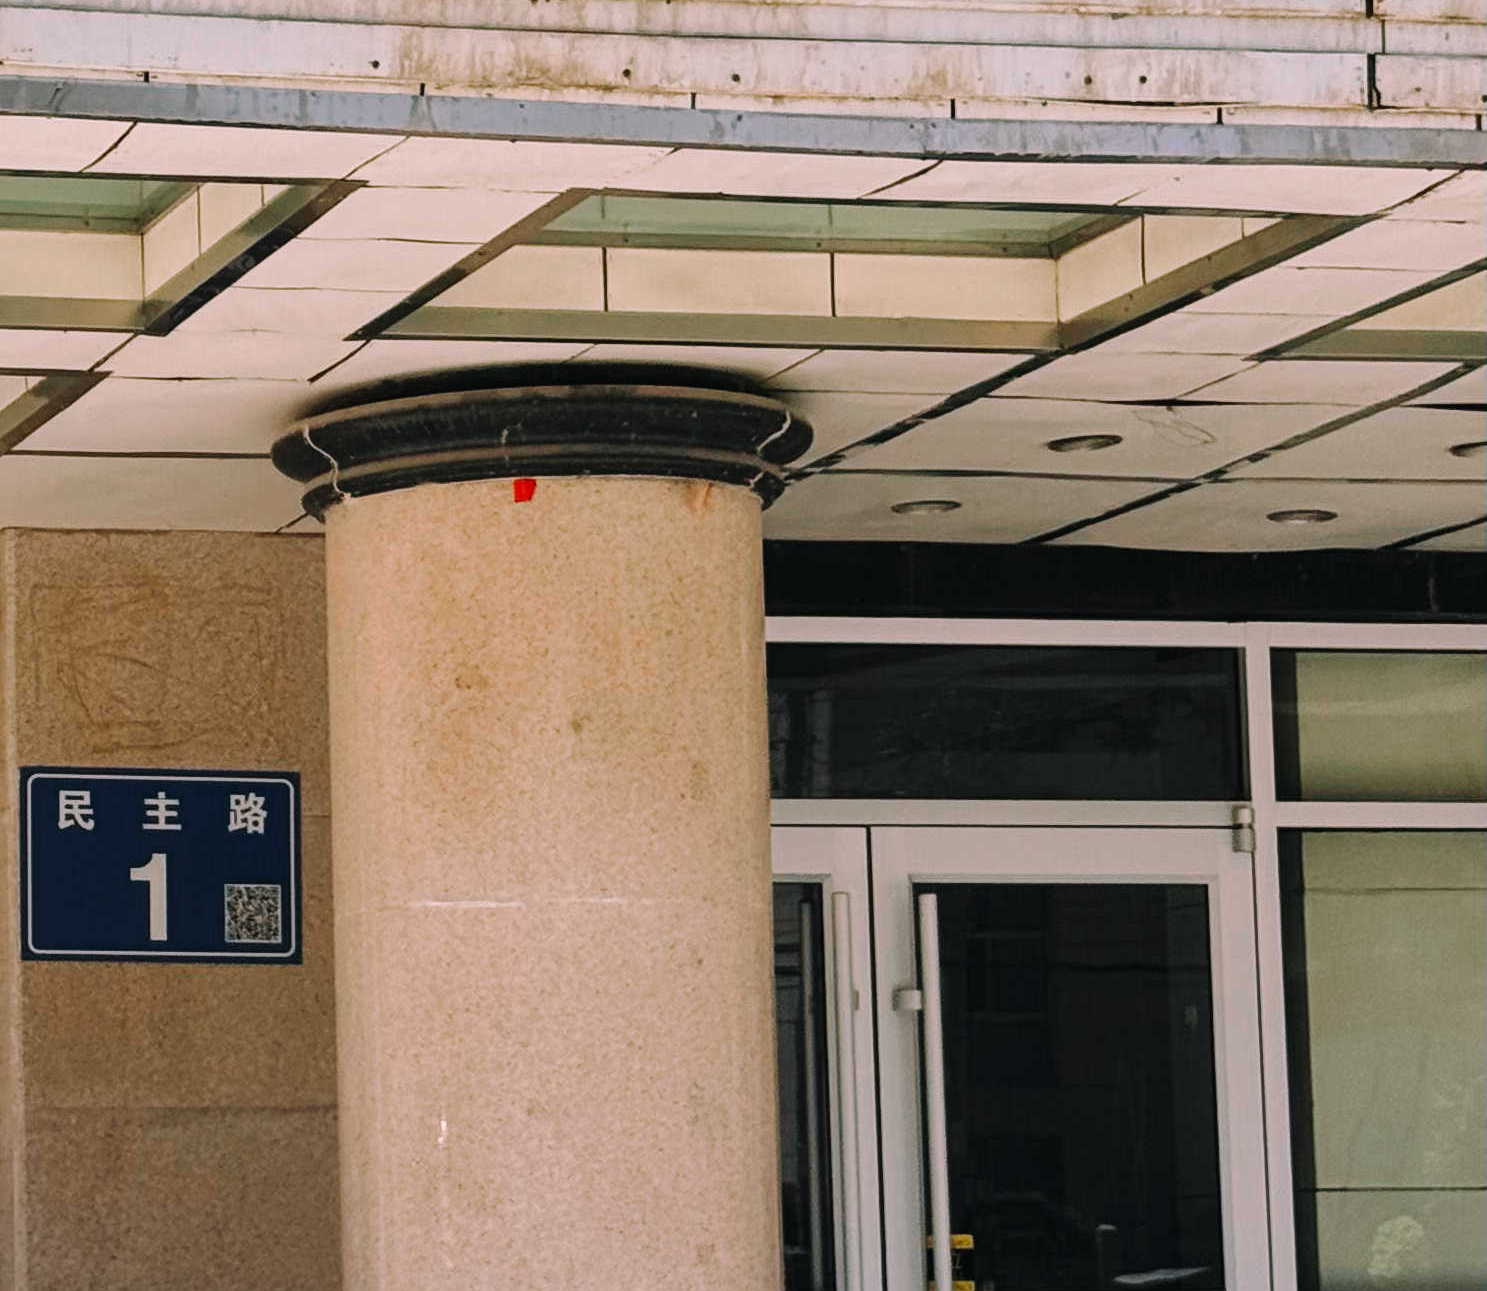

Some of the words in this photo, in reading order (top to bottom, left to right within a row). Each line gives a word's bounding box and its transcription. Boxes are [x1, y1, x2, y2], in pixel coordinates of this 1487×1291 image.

[57, 789, 268, 835] 民主路
[129, 852, 168, 942] 1
